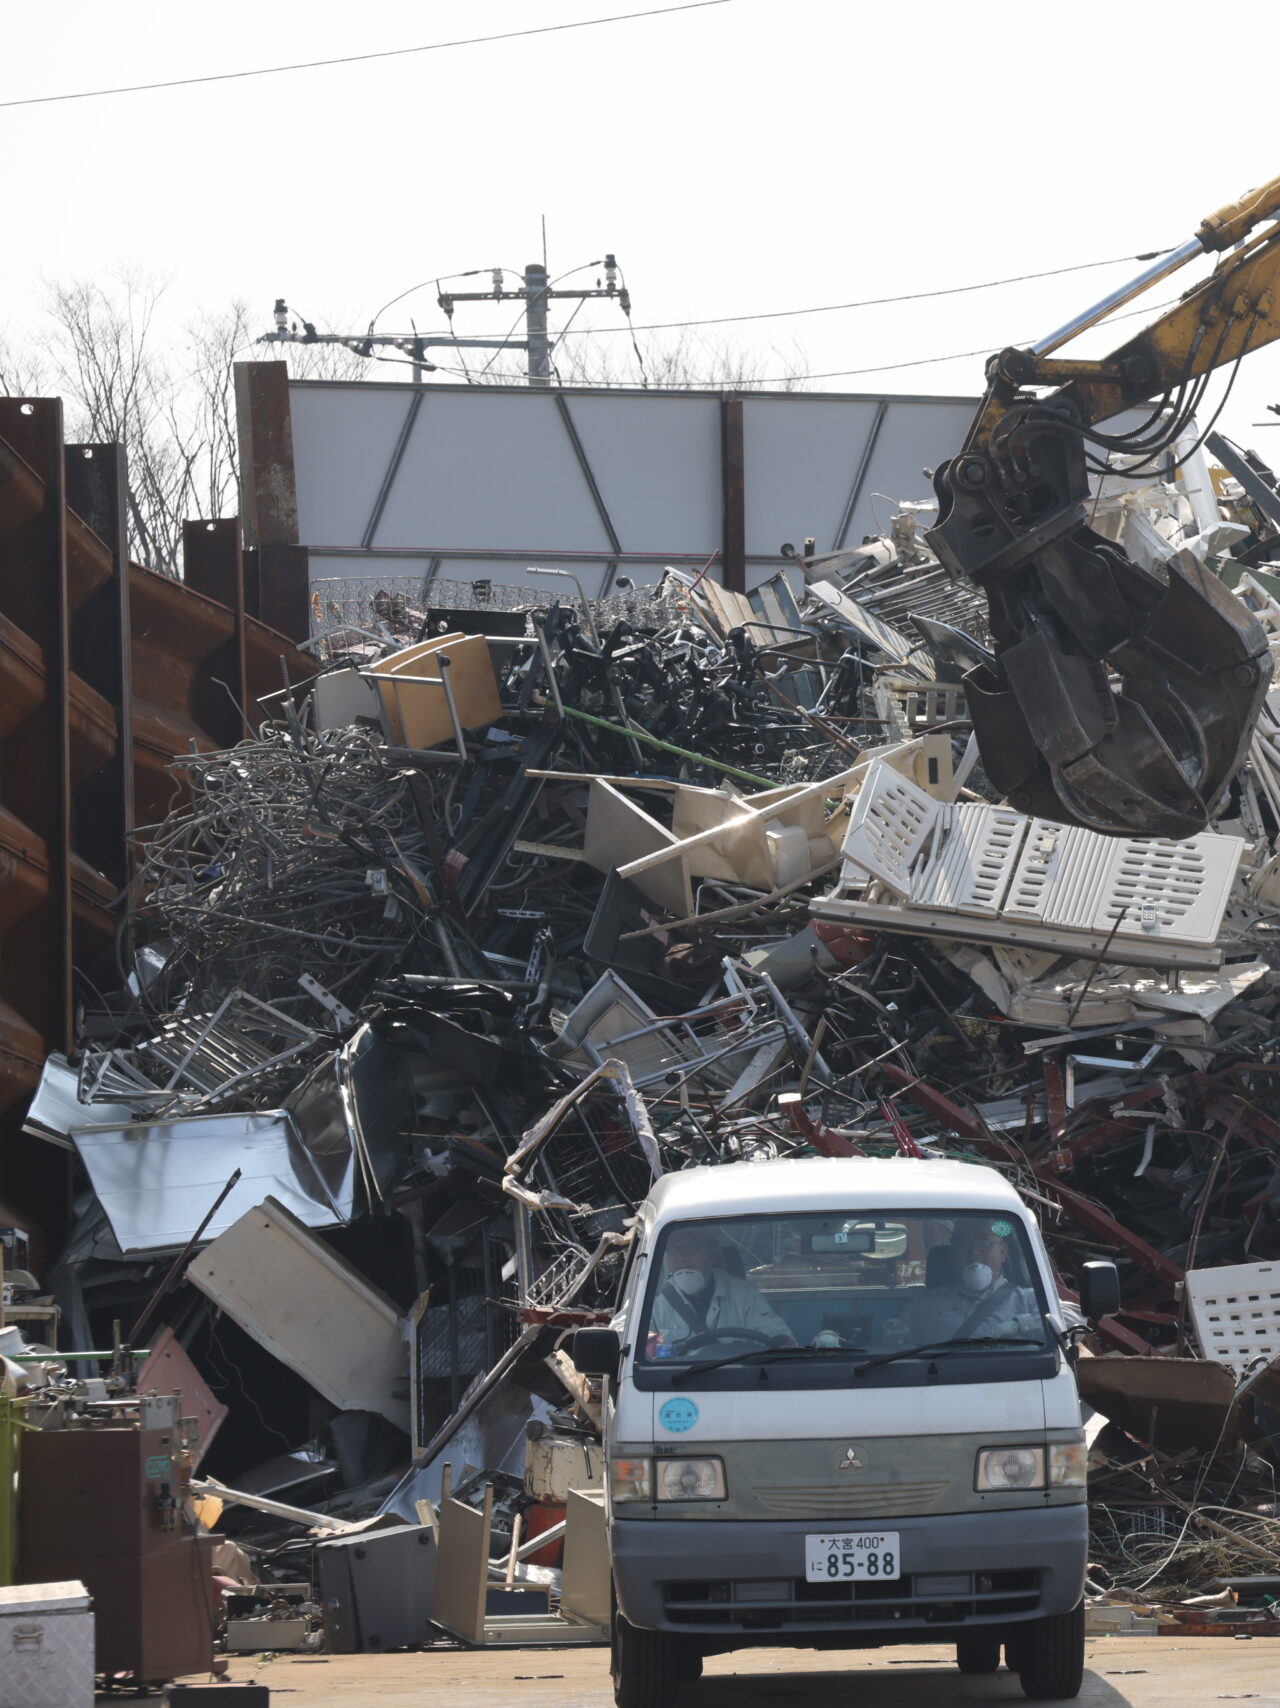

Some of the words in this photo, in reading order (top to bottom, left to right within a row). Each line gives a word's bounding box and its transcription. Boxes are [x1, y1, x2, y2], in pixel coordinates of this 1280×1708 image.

[828, 1538, 853, 1550] 大宮
[856, 1536, 879, 1549] 400
[811, 1561, 823, 1571] に
[827, 1552, 895, 1577] 85-88
